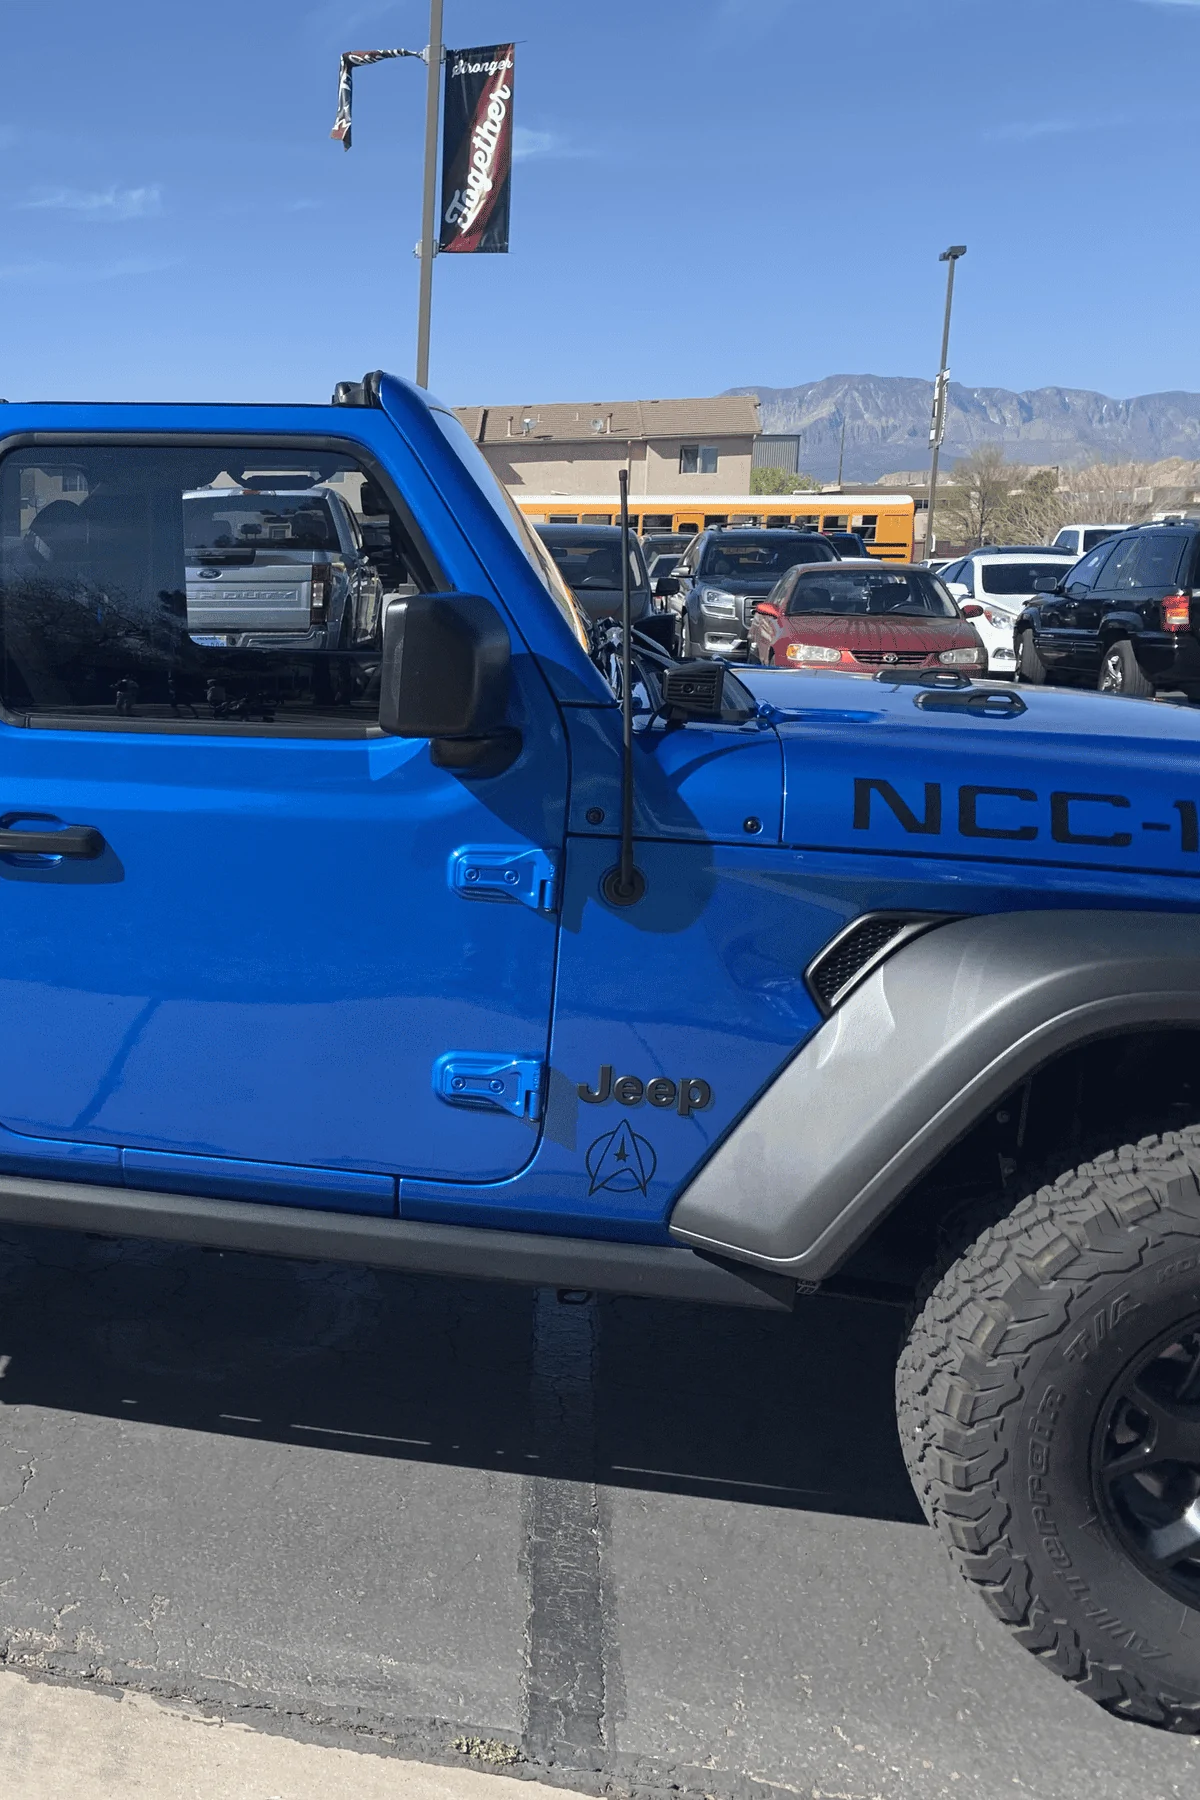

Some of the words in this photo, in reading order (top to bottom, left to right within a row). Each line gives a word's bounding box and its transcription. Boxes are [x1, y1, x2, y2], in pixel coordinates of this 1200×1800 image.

[452, 58, 513, 78] Stronger
[445, 84, 511, 234] Together
[853, 778, 1199, 852] NCC-1
[577, 1064, 711, 1116] Jeep
